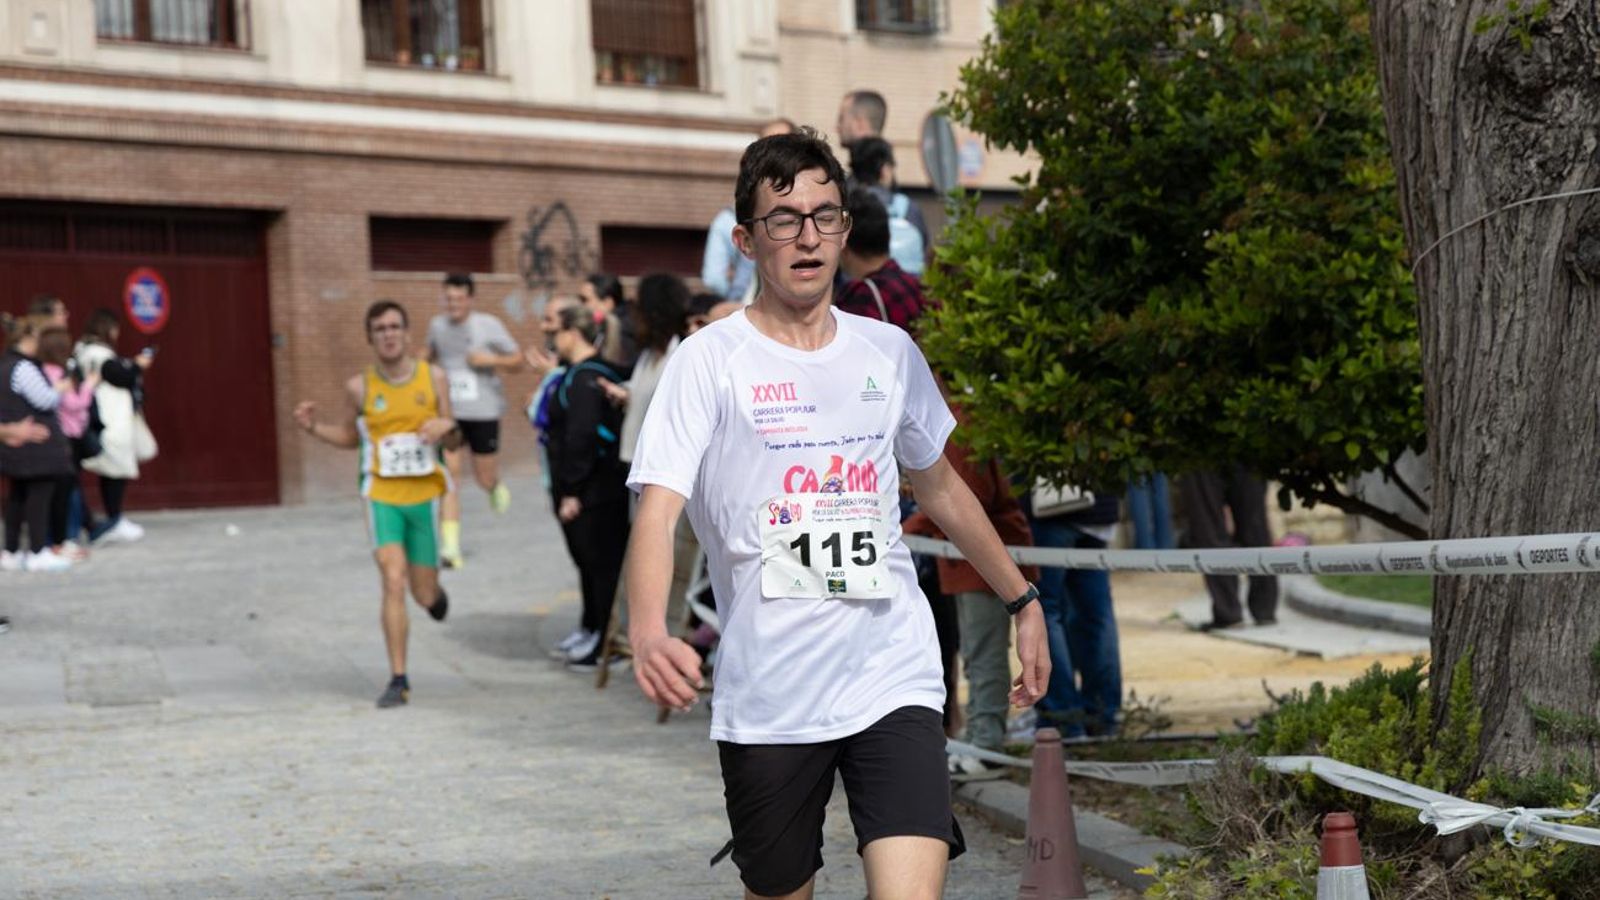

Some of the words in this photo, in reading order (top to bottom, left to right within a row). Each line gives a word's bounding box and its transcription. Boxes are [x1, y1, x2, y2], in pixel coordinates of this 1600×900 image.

[752, 382, 798, 404] XXVII
[753, 406, 784, 417] CARRERA
[790, 530, 877, 568] 115
[1529, 547, 1569, 564] DEPORTES
[825, 570, 845, 578] PACO
